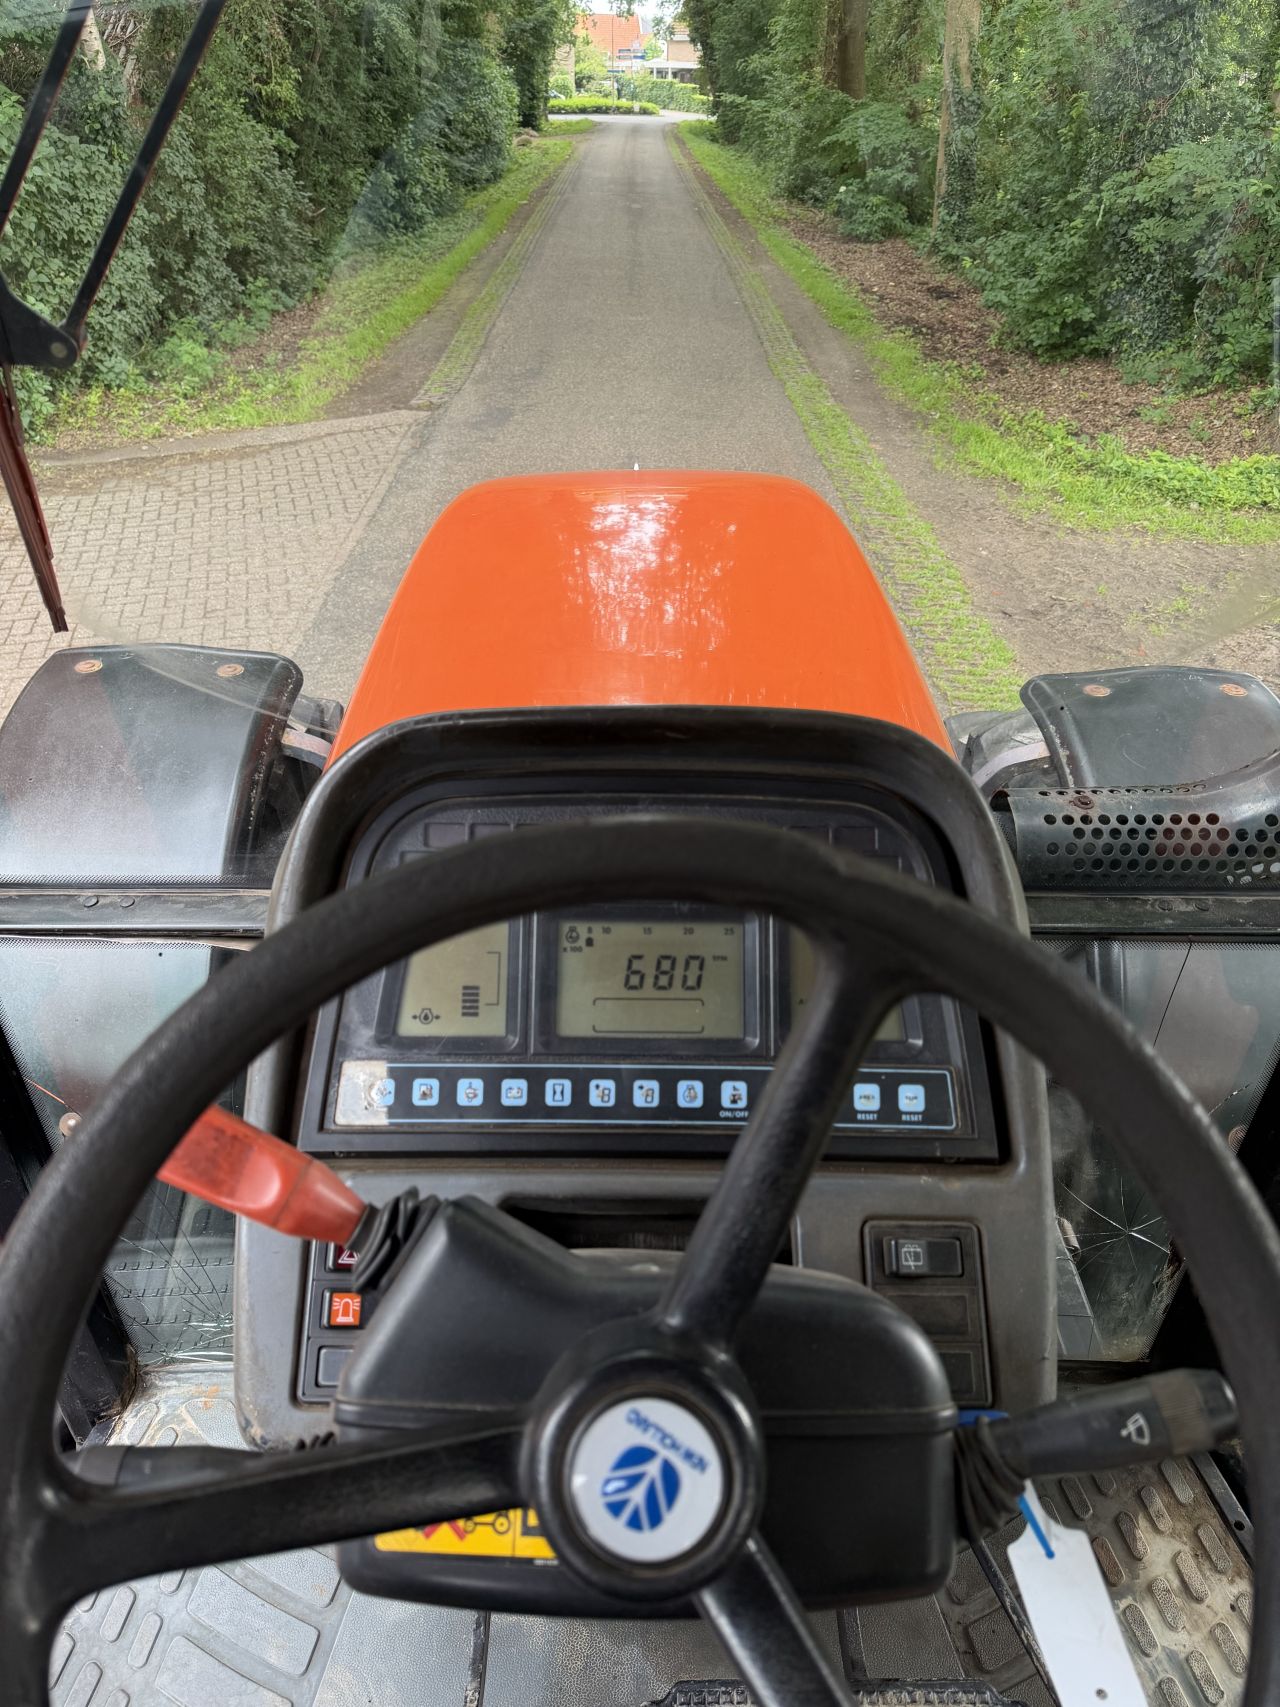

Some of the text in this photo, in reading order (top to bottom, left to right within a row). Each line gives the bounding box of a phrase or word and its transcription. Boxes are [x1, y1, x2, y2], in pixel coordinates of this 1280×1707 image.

[601, 927, 612, 935] 10
[643, 927, 653, 935] 15
[683, 927, 695, 935] 20
[723, 928, 735, 936] 25
[624, 955, 705, 991] 680
[719, 1110, 749, 1118] ON/OFF
[857, 1113, 878, 1121] RESET
[902, 1114, 923, 1122] RESET
[626, 1408, 709, 1474] NEW HOLLAND
